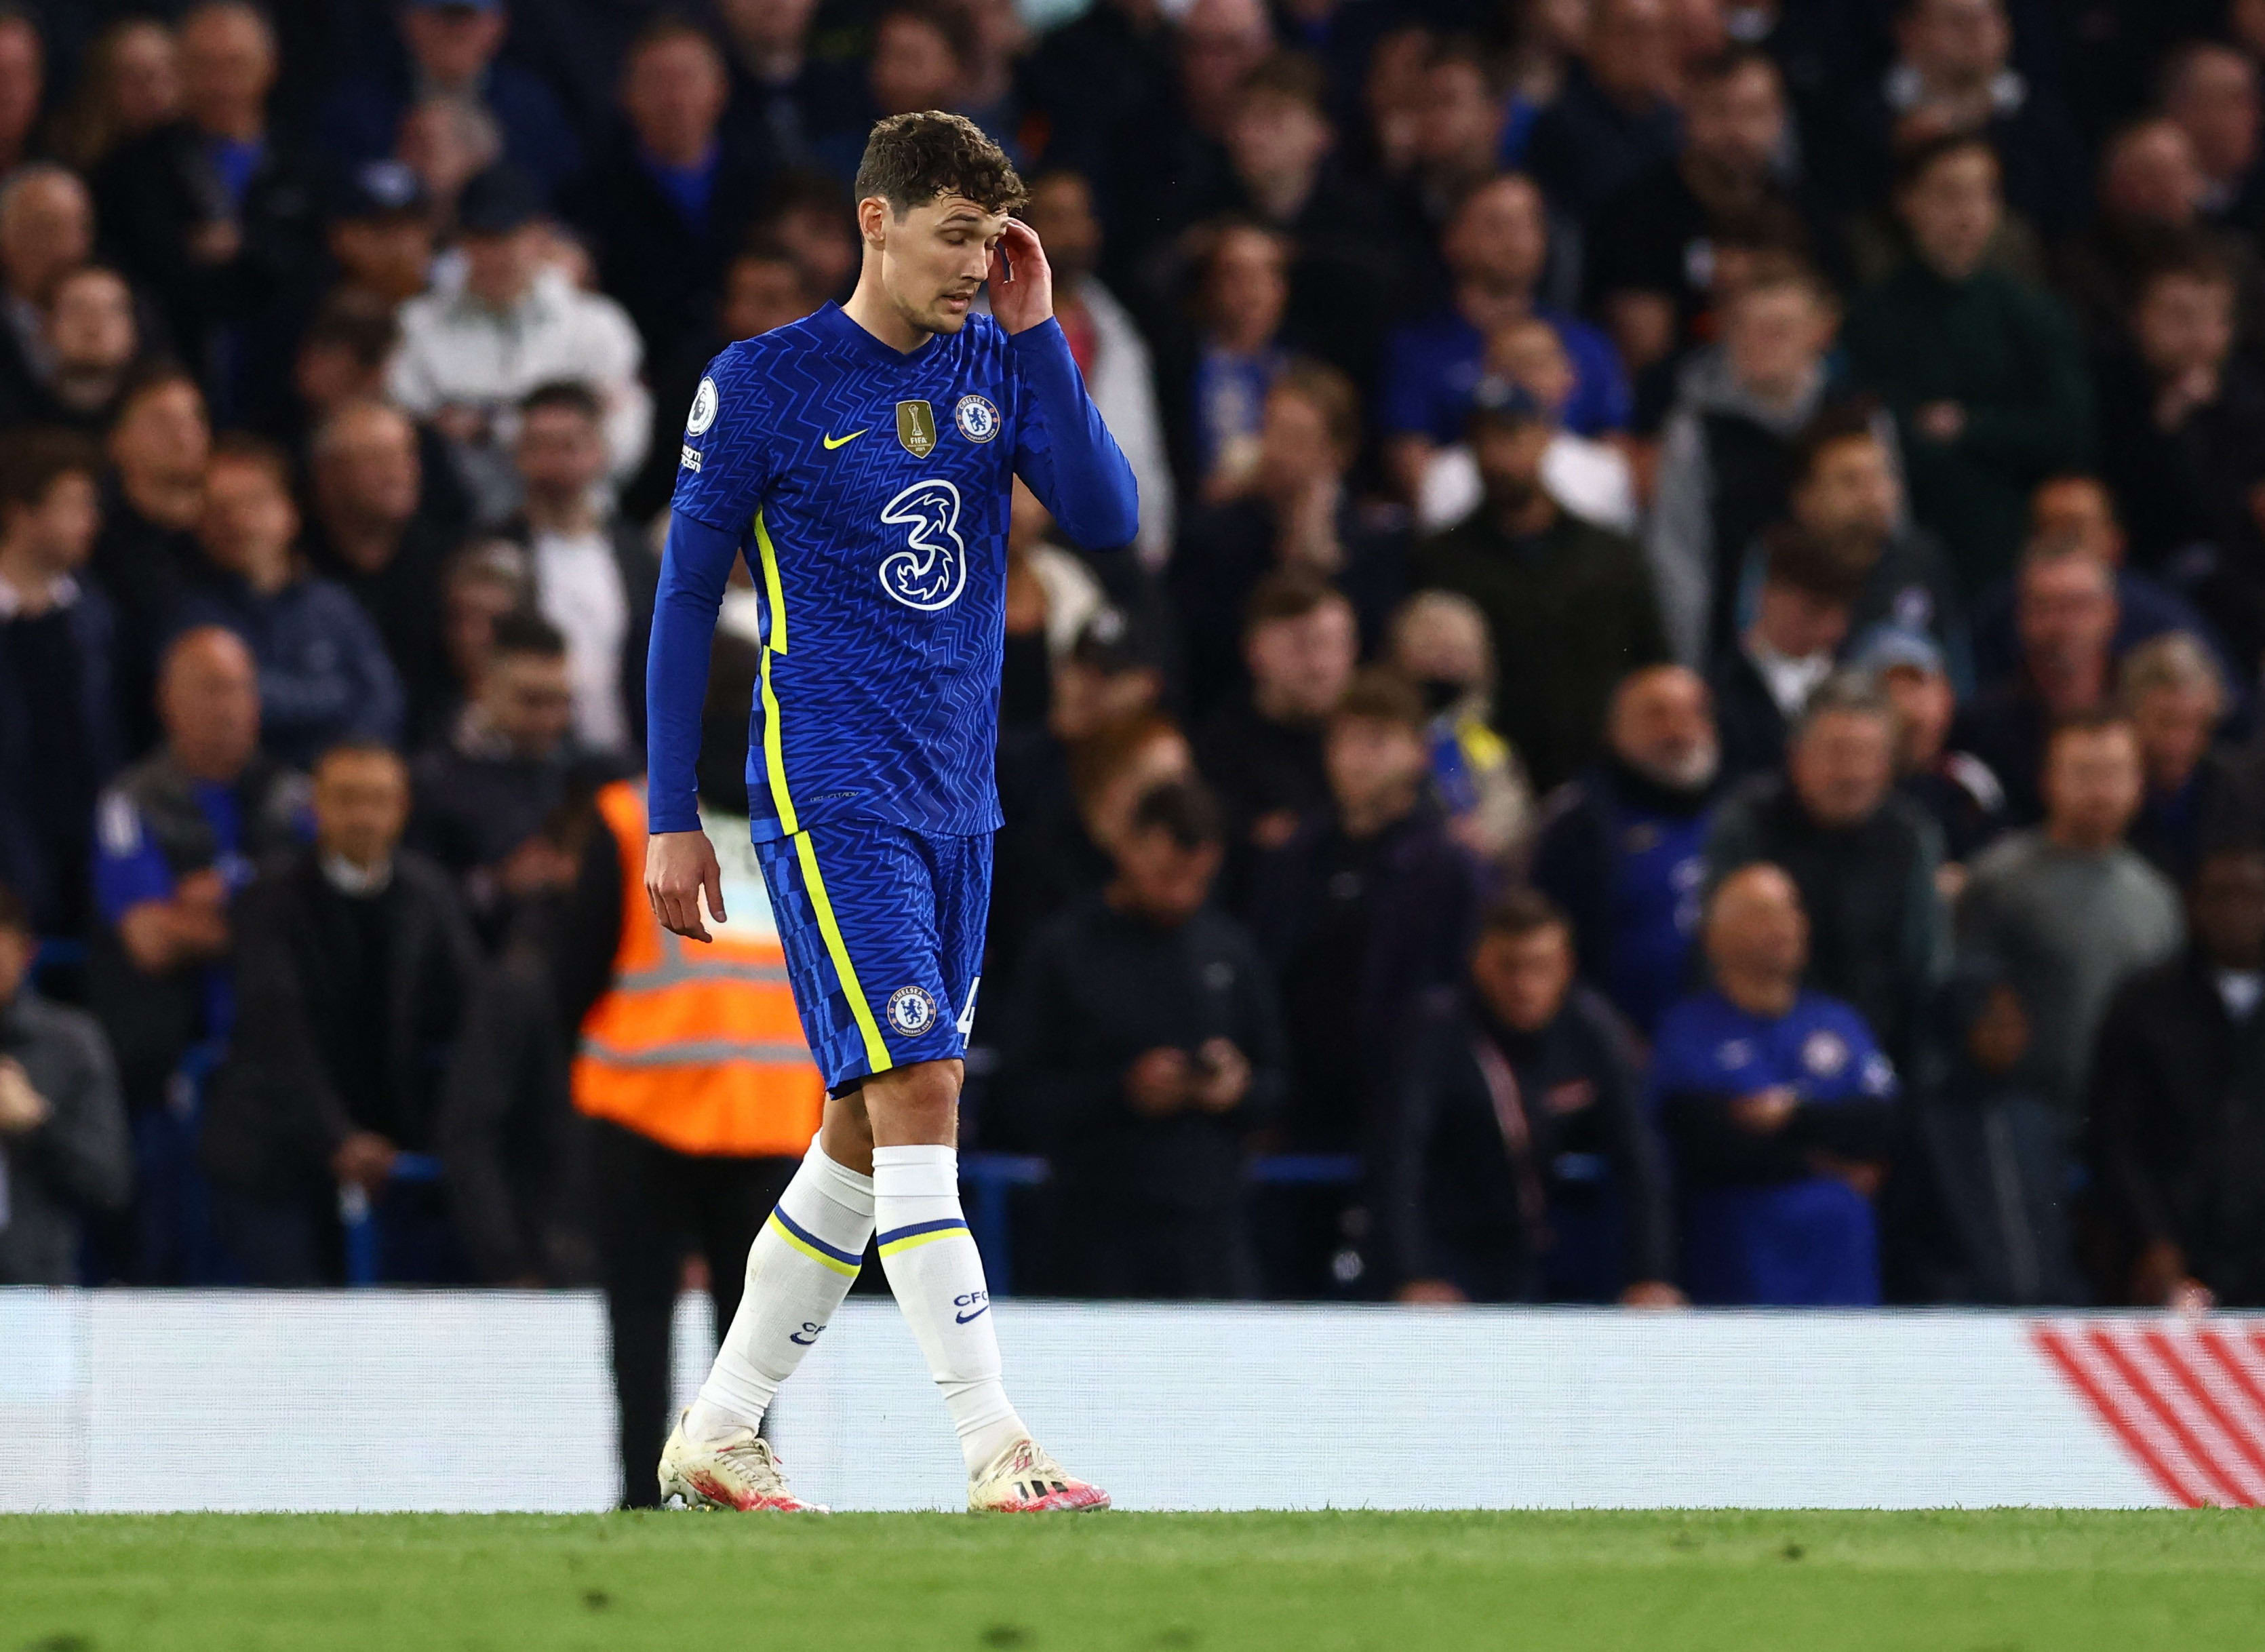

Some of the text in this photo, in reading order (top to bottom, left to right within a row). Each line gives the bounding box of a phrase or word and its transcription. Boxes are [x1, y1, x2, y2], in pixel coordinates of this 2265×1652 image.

[959, 397, 985, 409] CHELSEA
[879, 479, 966, 610] 3
[893, 987, 922, 1002] CHELSEA
[953, 1290, 987, 1307] CFC
